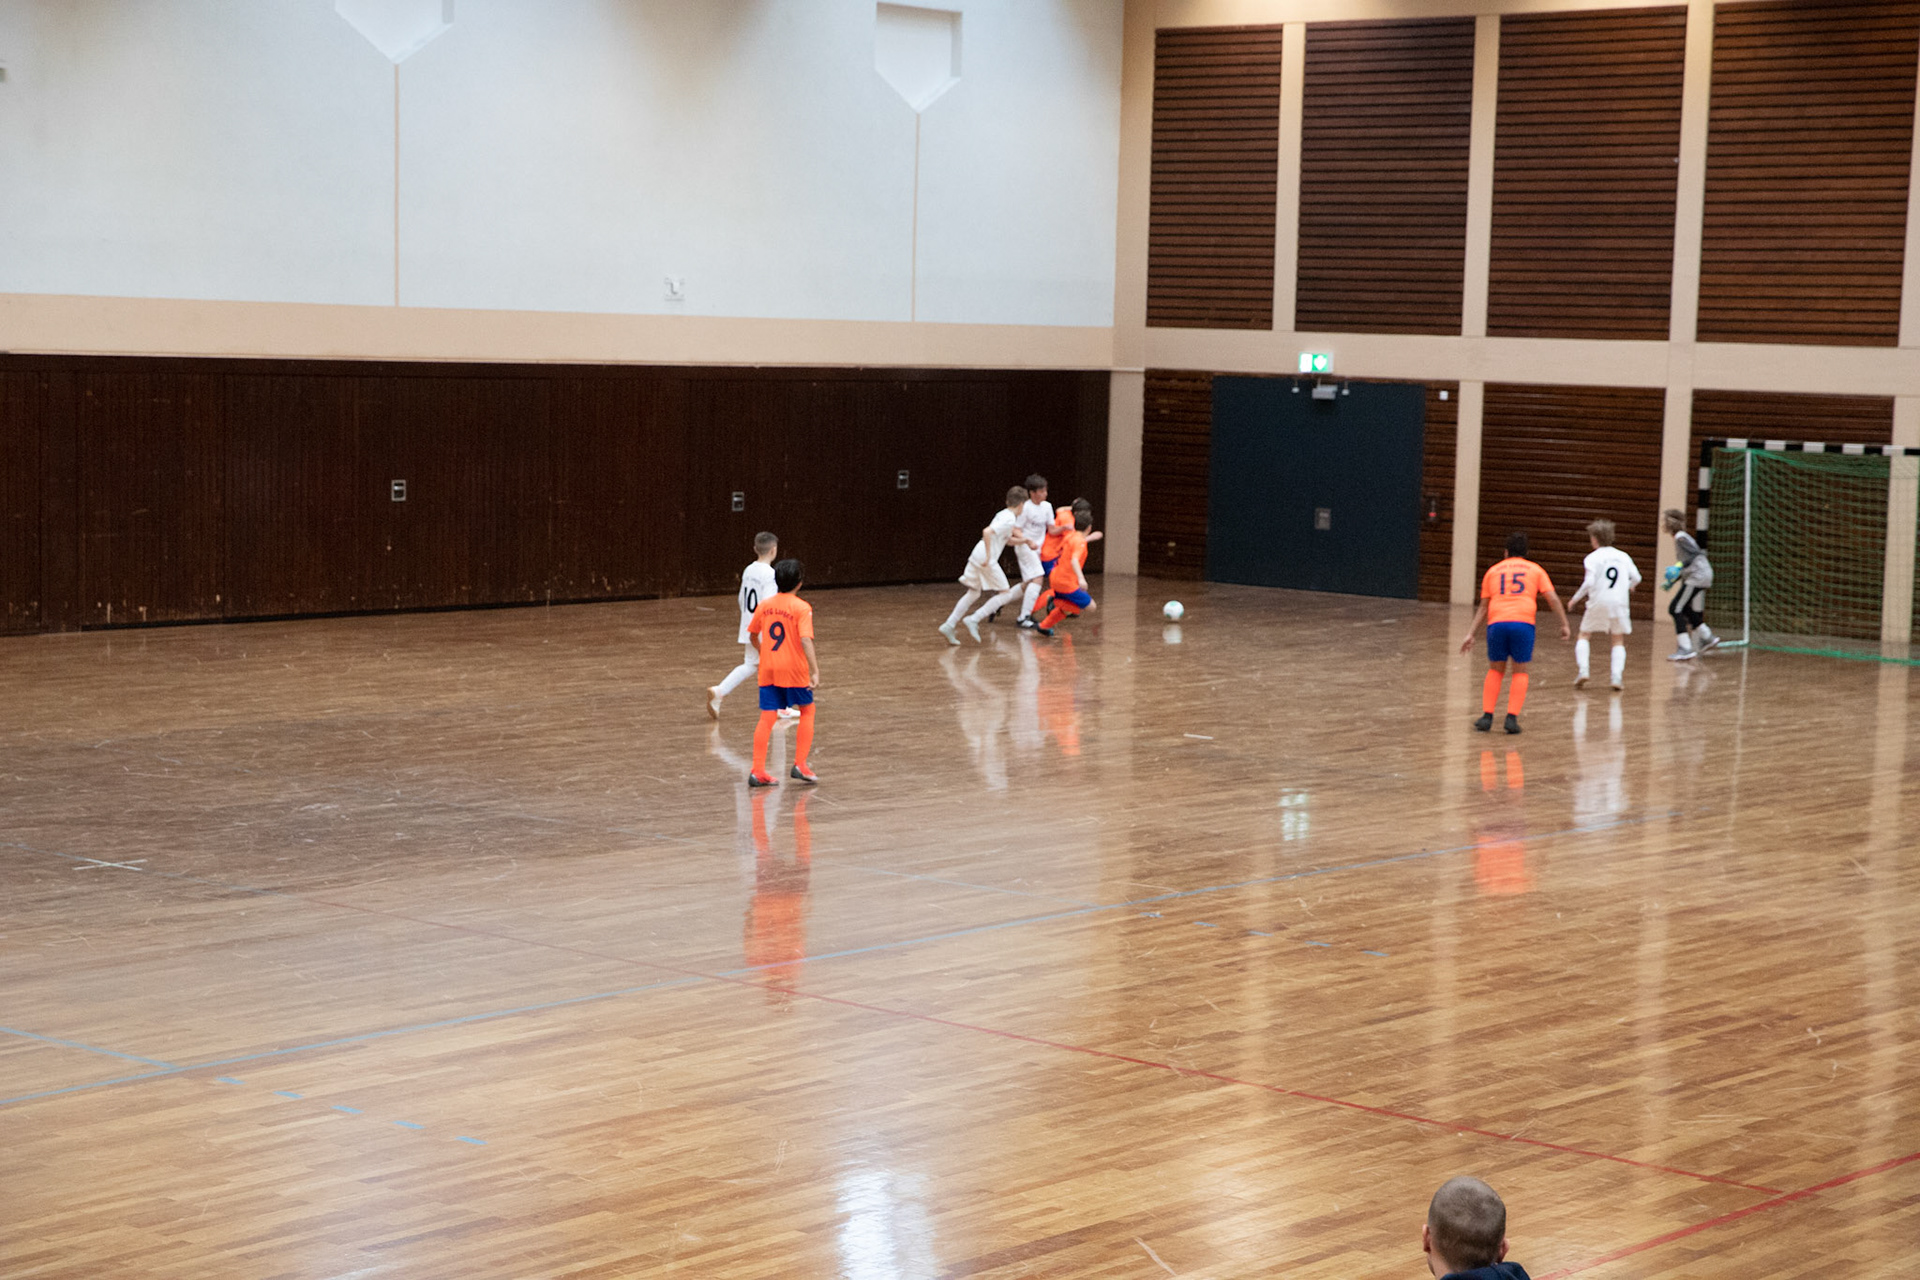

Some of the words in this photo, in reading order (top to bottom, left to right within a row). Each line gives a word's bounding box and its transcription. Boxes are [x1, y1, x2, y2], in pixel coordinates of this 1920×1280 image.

[1500, 573, 1525, 594] 15
[1606, 567, 1618, 589] 9
[744, 587, 758, 613] 10
[769, 621, 785, 651] 9
